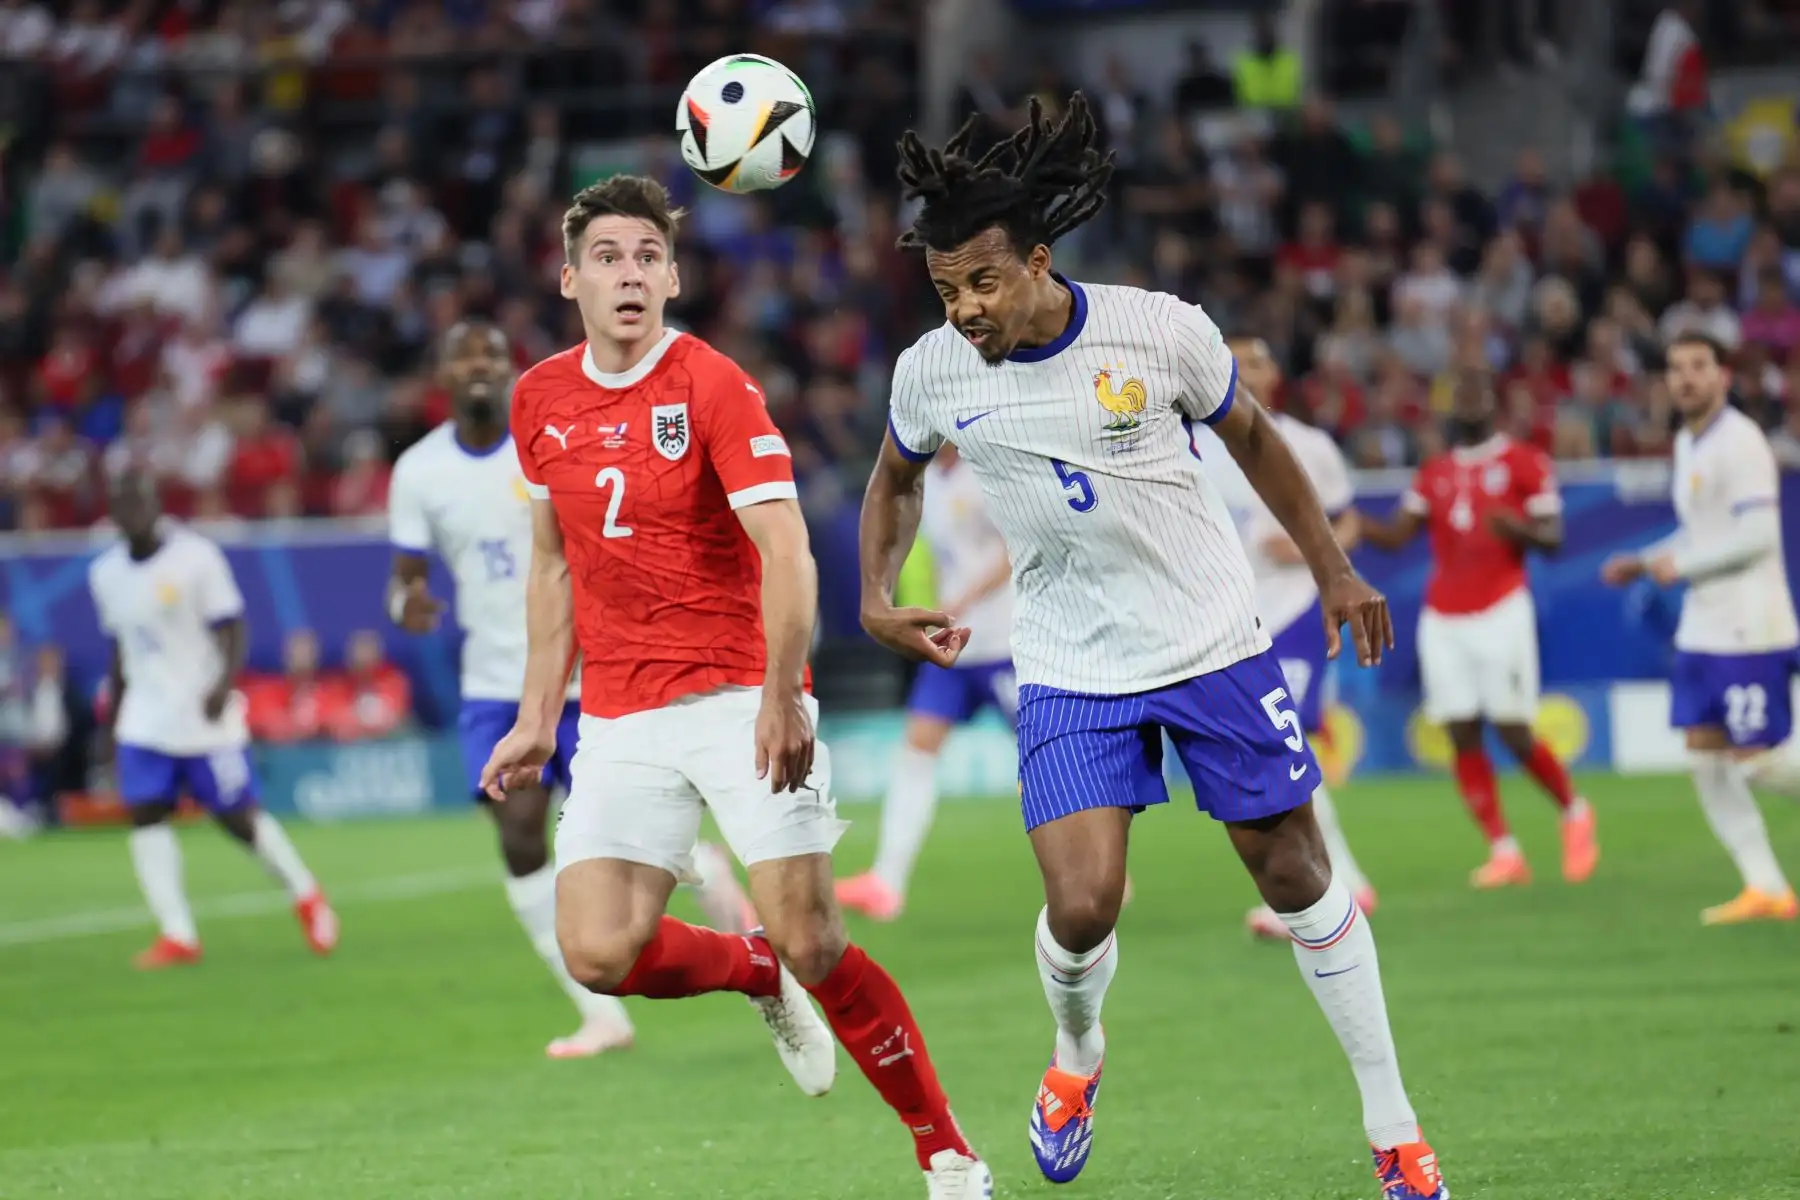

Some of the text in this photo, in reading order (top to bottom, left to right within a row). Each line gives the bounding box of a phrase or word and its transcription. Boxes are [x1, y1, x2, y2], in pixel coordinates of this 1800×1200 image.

[595, 466, 633, 538] 2
[1050, 458, 1098, 513] 5
[1259, 687, 1303, 752] 5
